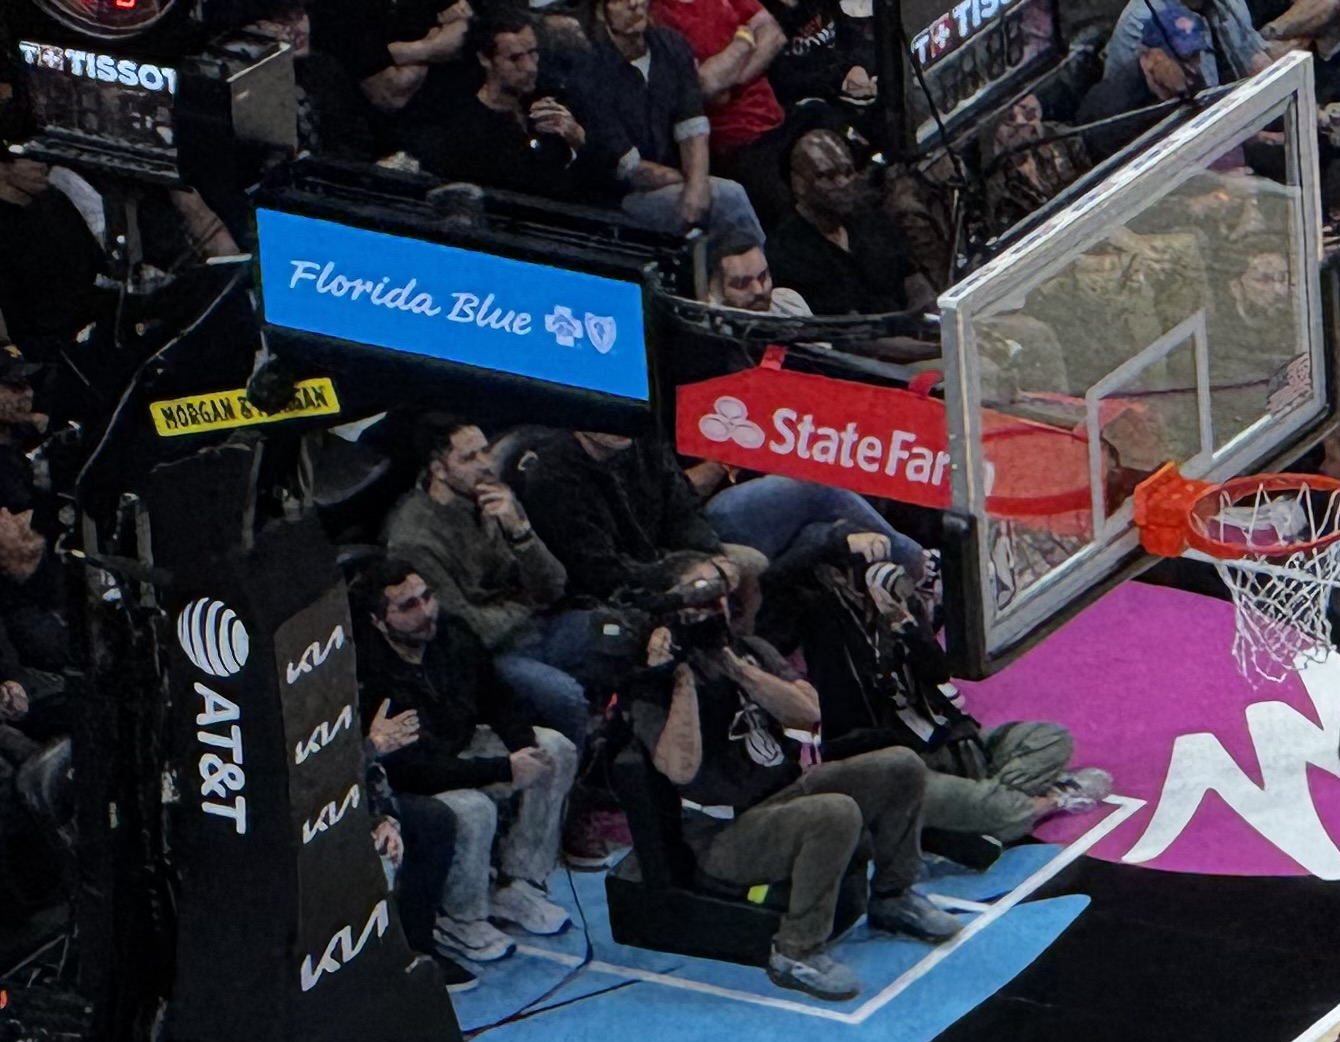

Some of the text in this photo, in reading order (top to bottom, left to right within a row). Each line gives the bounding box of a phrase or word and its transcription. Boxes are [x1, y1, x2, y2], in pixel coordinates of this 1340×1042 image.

[289, 260, 532, 335] Florida Blue
[160, 396, 236, 429] MORGAN
[769, 407, 994, 498] State Far
[194, 681, 247, 835] AT&T
